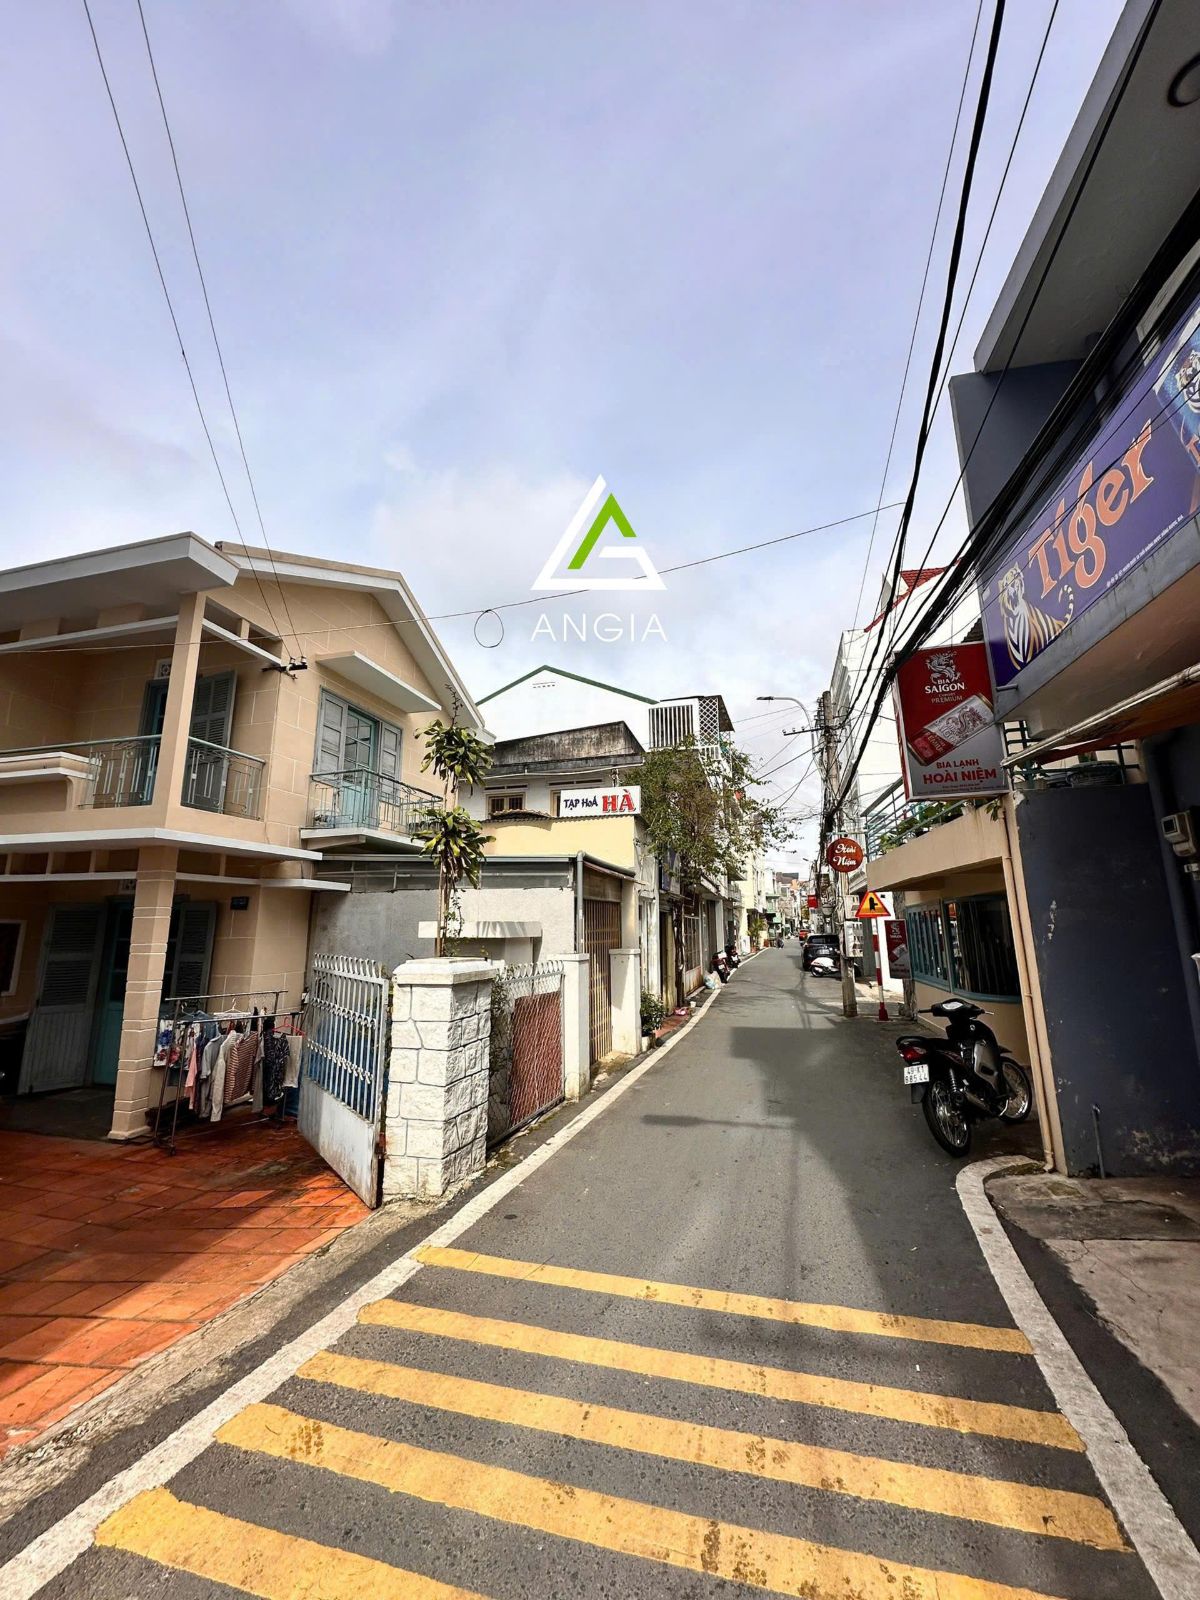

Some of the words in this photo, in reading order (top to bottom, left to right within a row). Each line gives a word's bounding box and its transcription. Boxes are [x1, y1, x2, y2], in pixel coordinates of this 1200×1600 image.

[1028, 418, 1155, 600] Tiger
[925, 682, 964, 693] SAIGON
[936, 761, 953, 769] BIA
[953, 758, 980, 769] LẠNH
[923, 769, 959, 785] HOÀI
[961, 767, 997, 783] NIỆM
[563, 798, 580, 811] TẠP
[602, 788, 637, 814] HÀ
